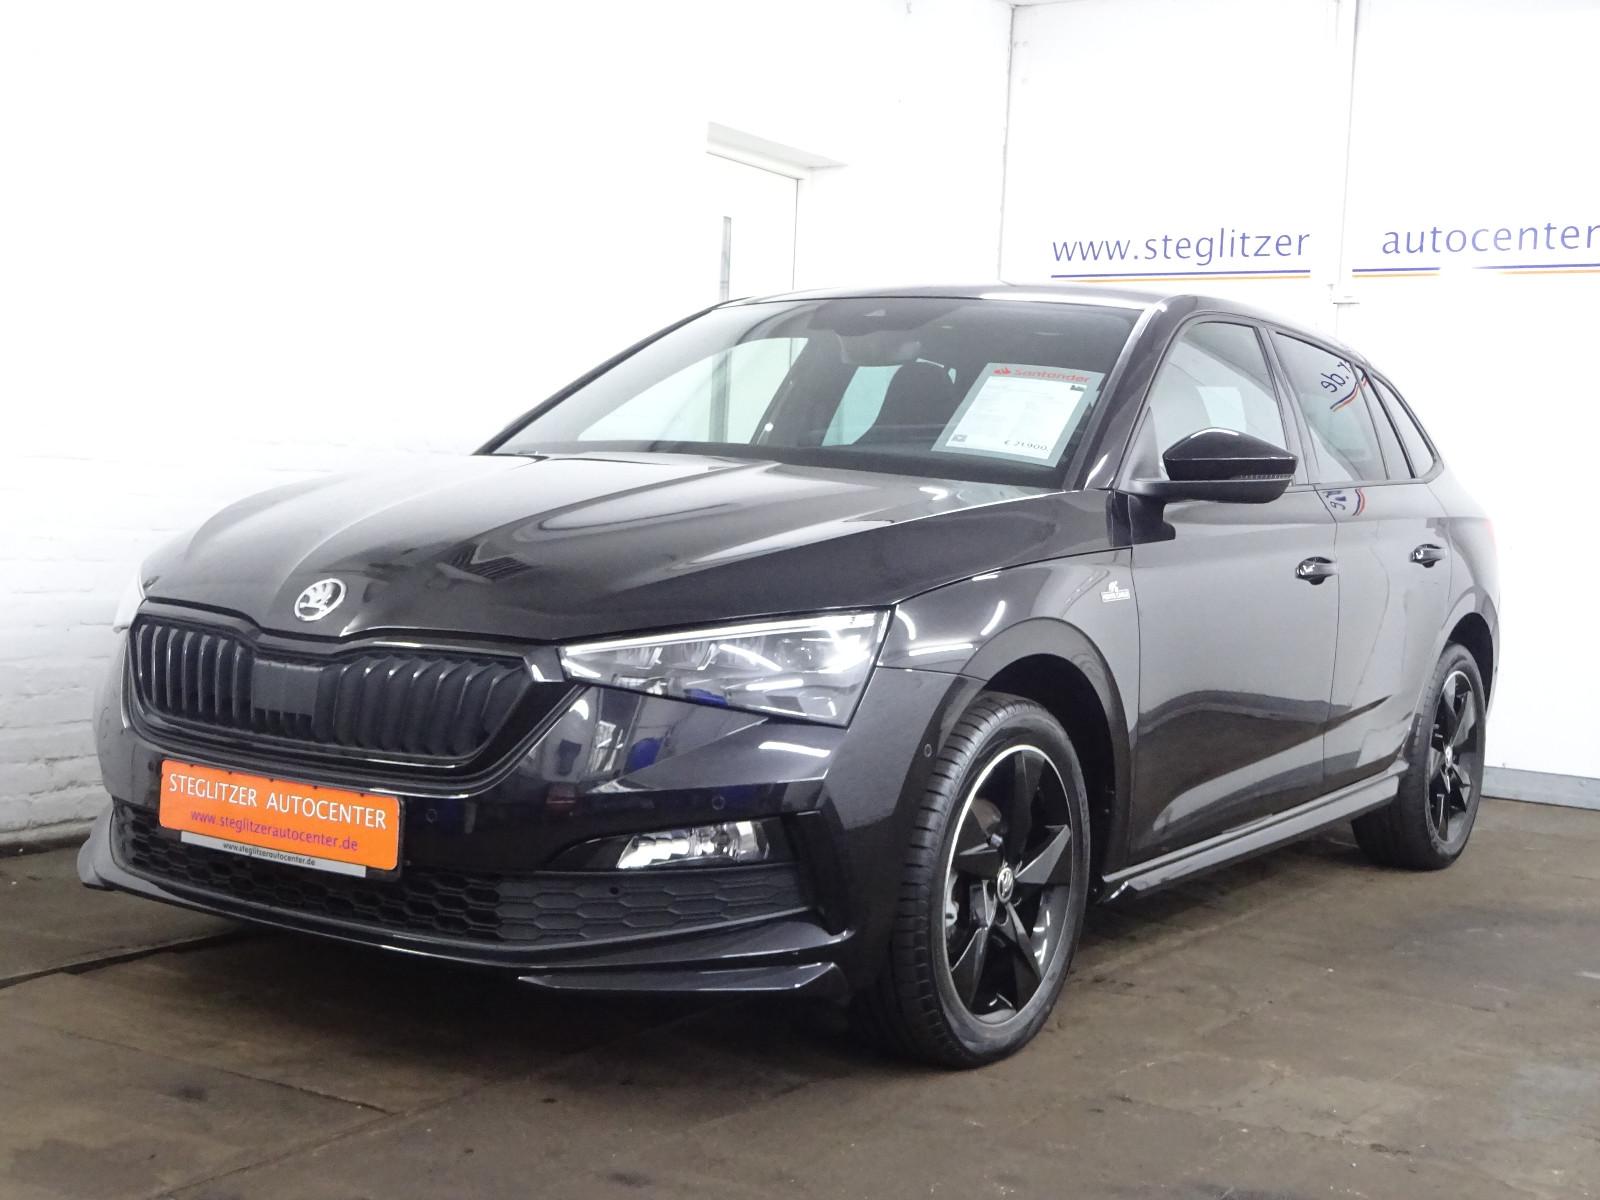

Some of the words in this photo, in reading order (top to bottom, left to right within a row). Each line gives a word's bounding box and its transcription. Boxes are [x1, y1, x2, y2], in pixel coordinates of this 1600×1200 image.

[1052, 228, 1310, 266] www.steglitzer
[1381, 222, 1600, 255] autocenter
[1014, 368, 1090, 383] Santander
[168, 773, 257, 807] STEGLITZER
[266, 793, 387, 829] AUTOCENTER
[190, 810, 358, 851] www.steglitzerautocenter.de
[223, 843, 316, 866] www.steglitzerautocenter.de
